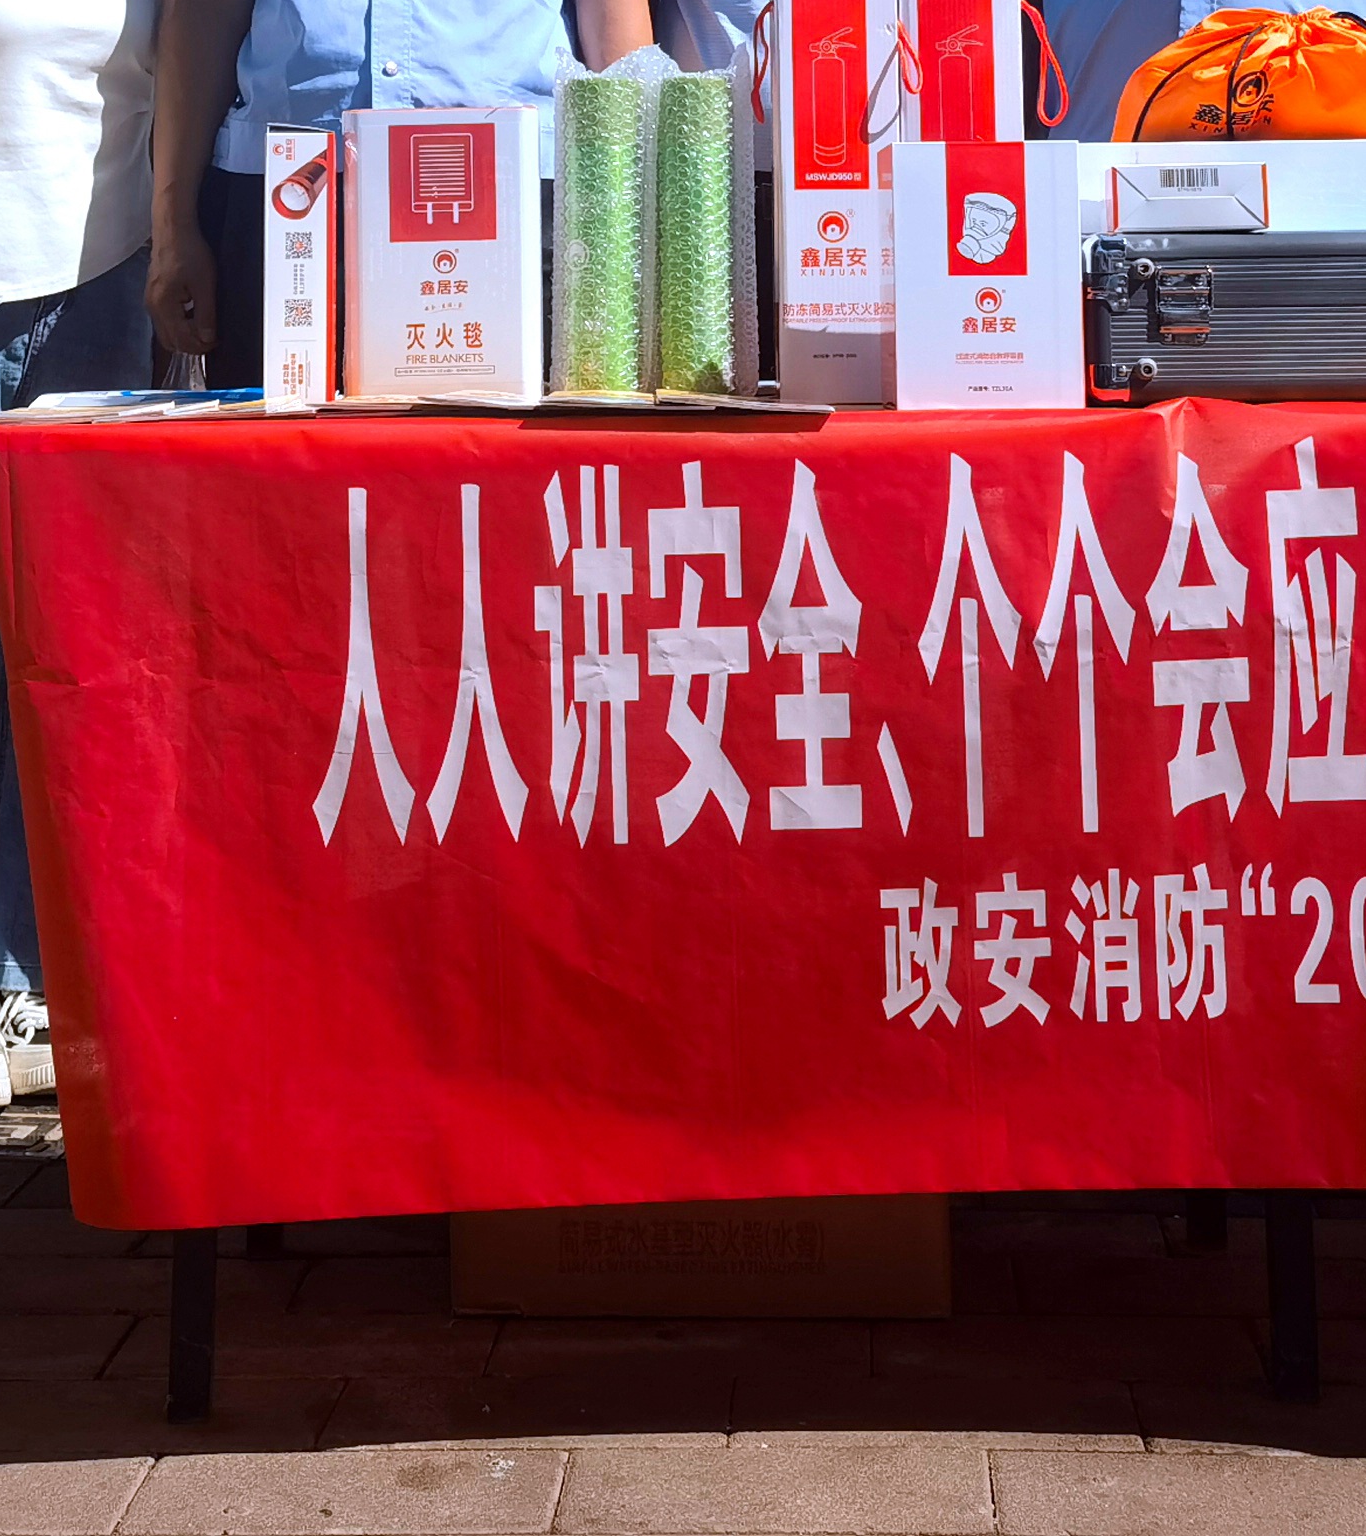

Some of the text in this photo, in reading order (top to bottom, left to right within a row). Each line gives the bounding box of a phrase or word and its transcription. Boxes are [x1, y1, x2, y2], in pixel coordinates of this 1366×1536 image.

[801, 248, 867, 267] 鑫居安
[801, 268, 867, 276] XINJUAN
[420, 280, 469, 296] 鑫居安
[962, 317, 1017, 334] 鑫居安
[406, 322, 483, 350] 灭火毯
[406, 353, 484, 364] FIRE BLANKETS
